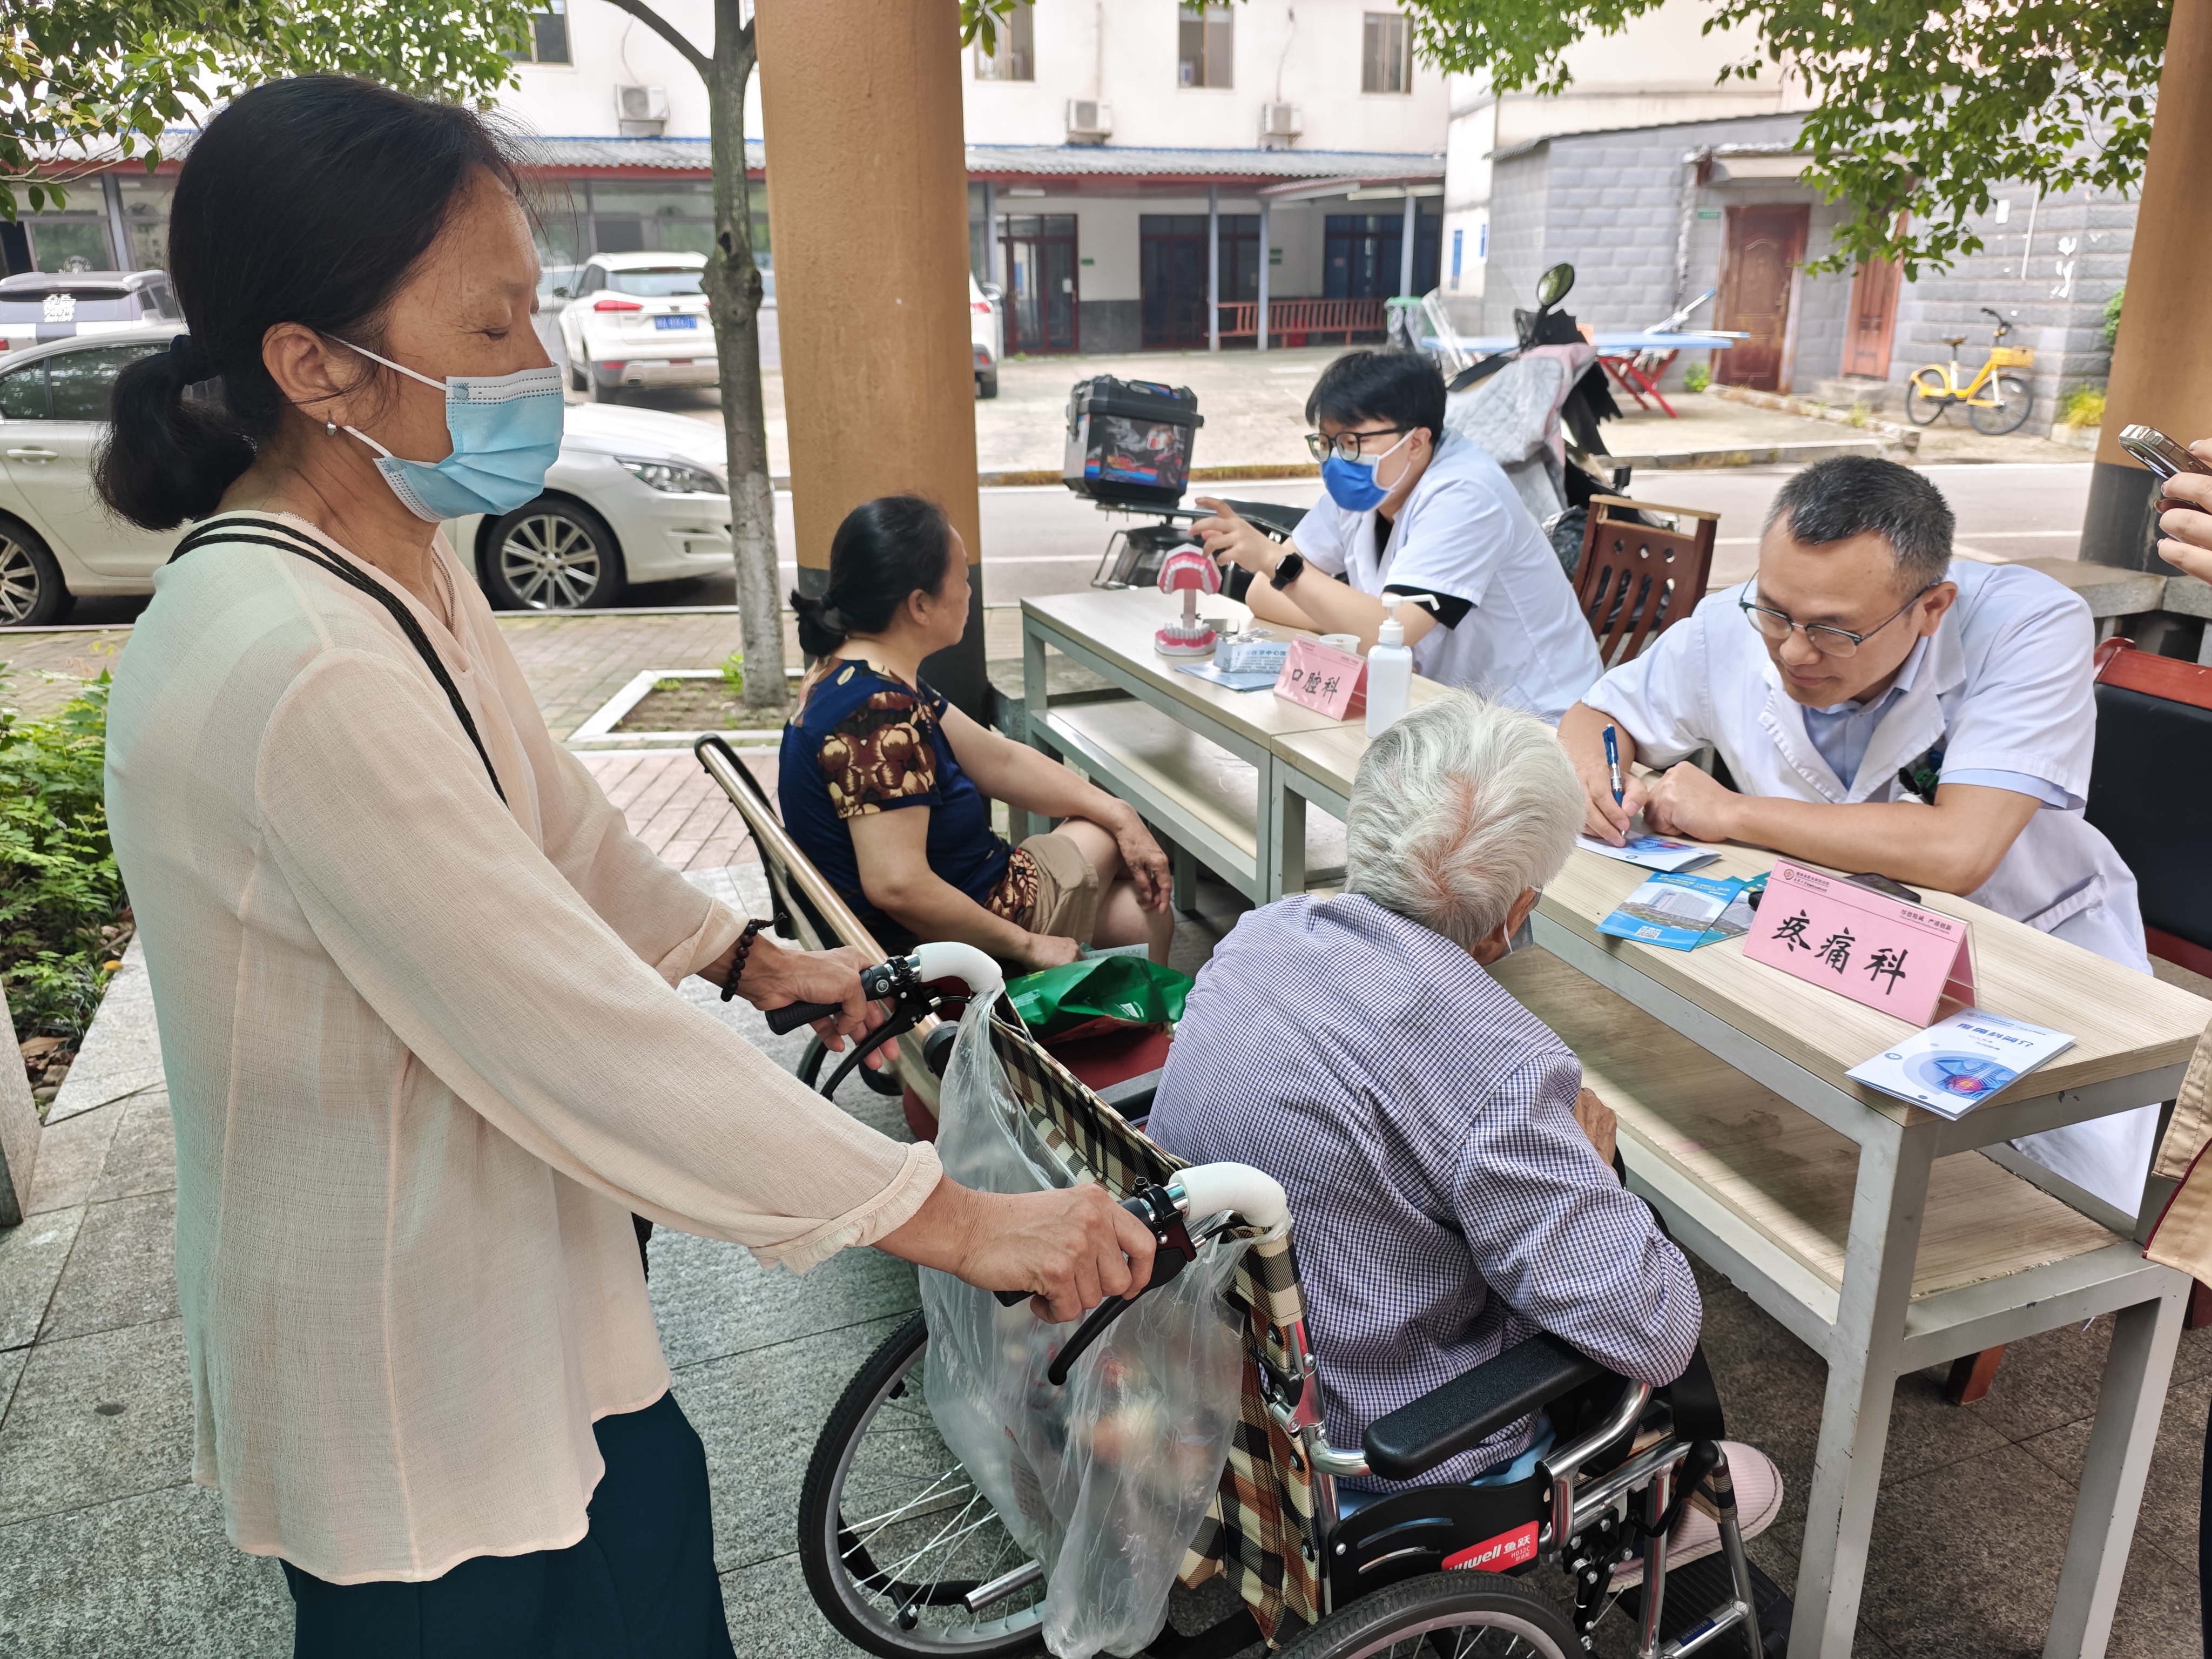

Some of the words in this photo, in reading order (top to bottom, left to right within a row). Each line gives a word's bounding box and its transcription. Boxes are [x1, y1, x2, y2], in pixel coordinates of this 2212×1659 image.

[1292, 669, 1340, 704] 口腔科
[1771, 909, 1908, 995] 疼痛科
[1503, 1534, 1530, 1554] 鱼跃
[1511, 1546, 1530, 1558] H032C
